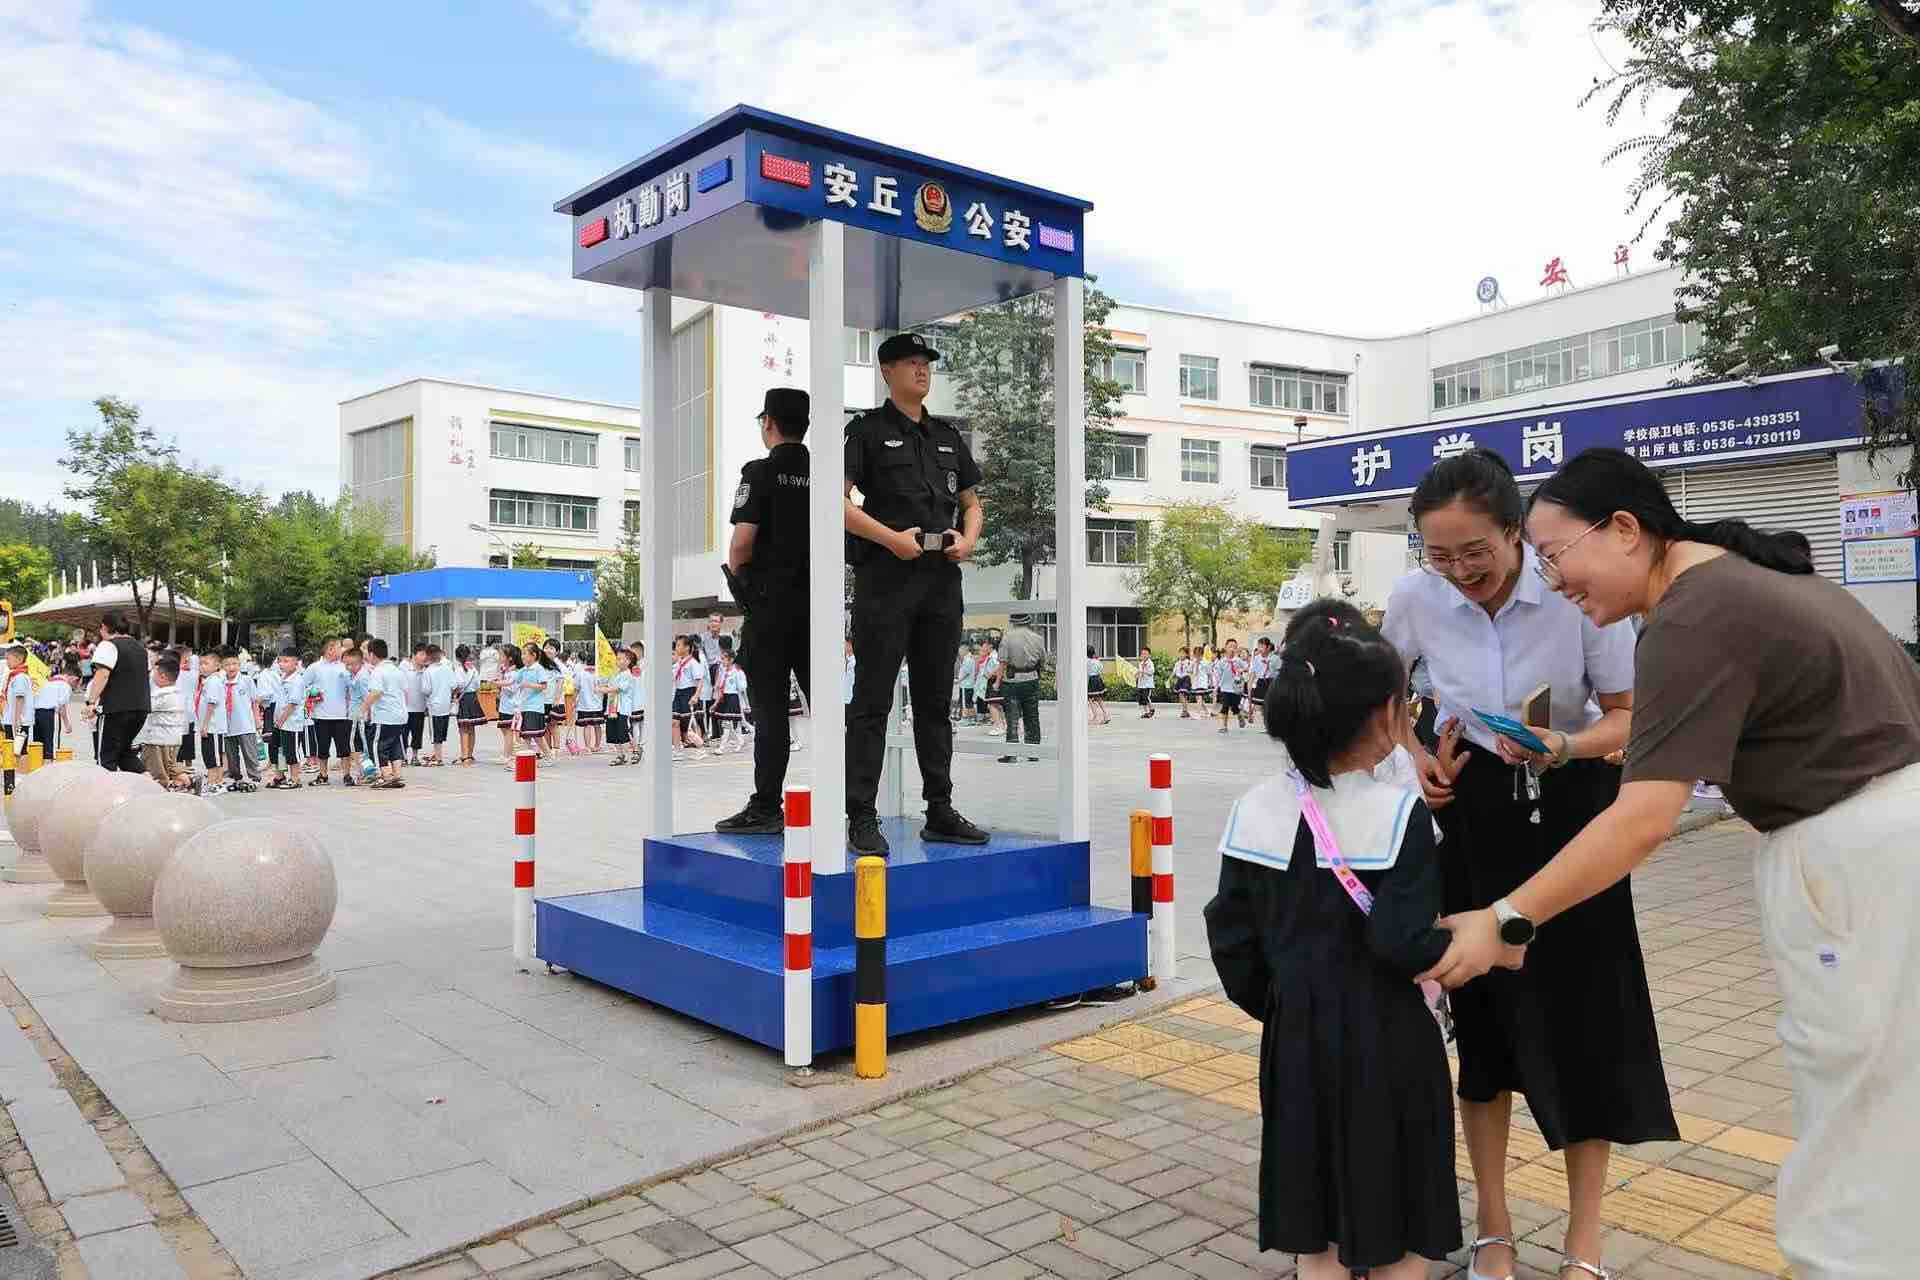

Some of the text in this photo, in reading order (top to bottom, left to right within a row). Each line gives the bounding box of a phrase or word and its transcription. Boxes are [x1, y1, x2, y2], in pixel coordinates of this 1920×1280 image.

[614, 170, 690, 240] 执勤岗
[823, 163, 1032, 251] 安丘 公安
